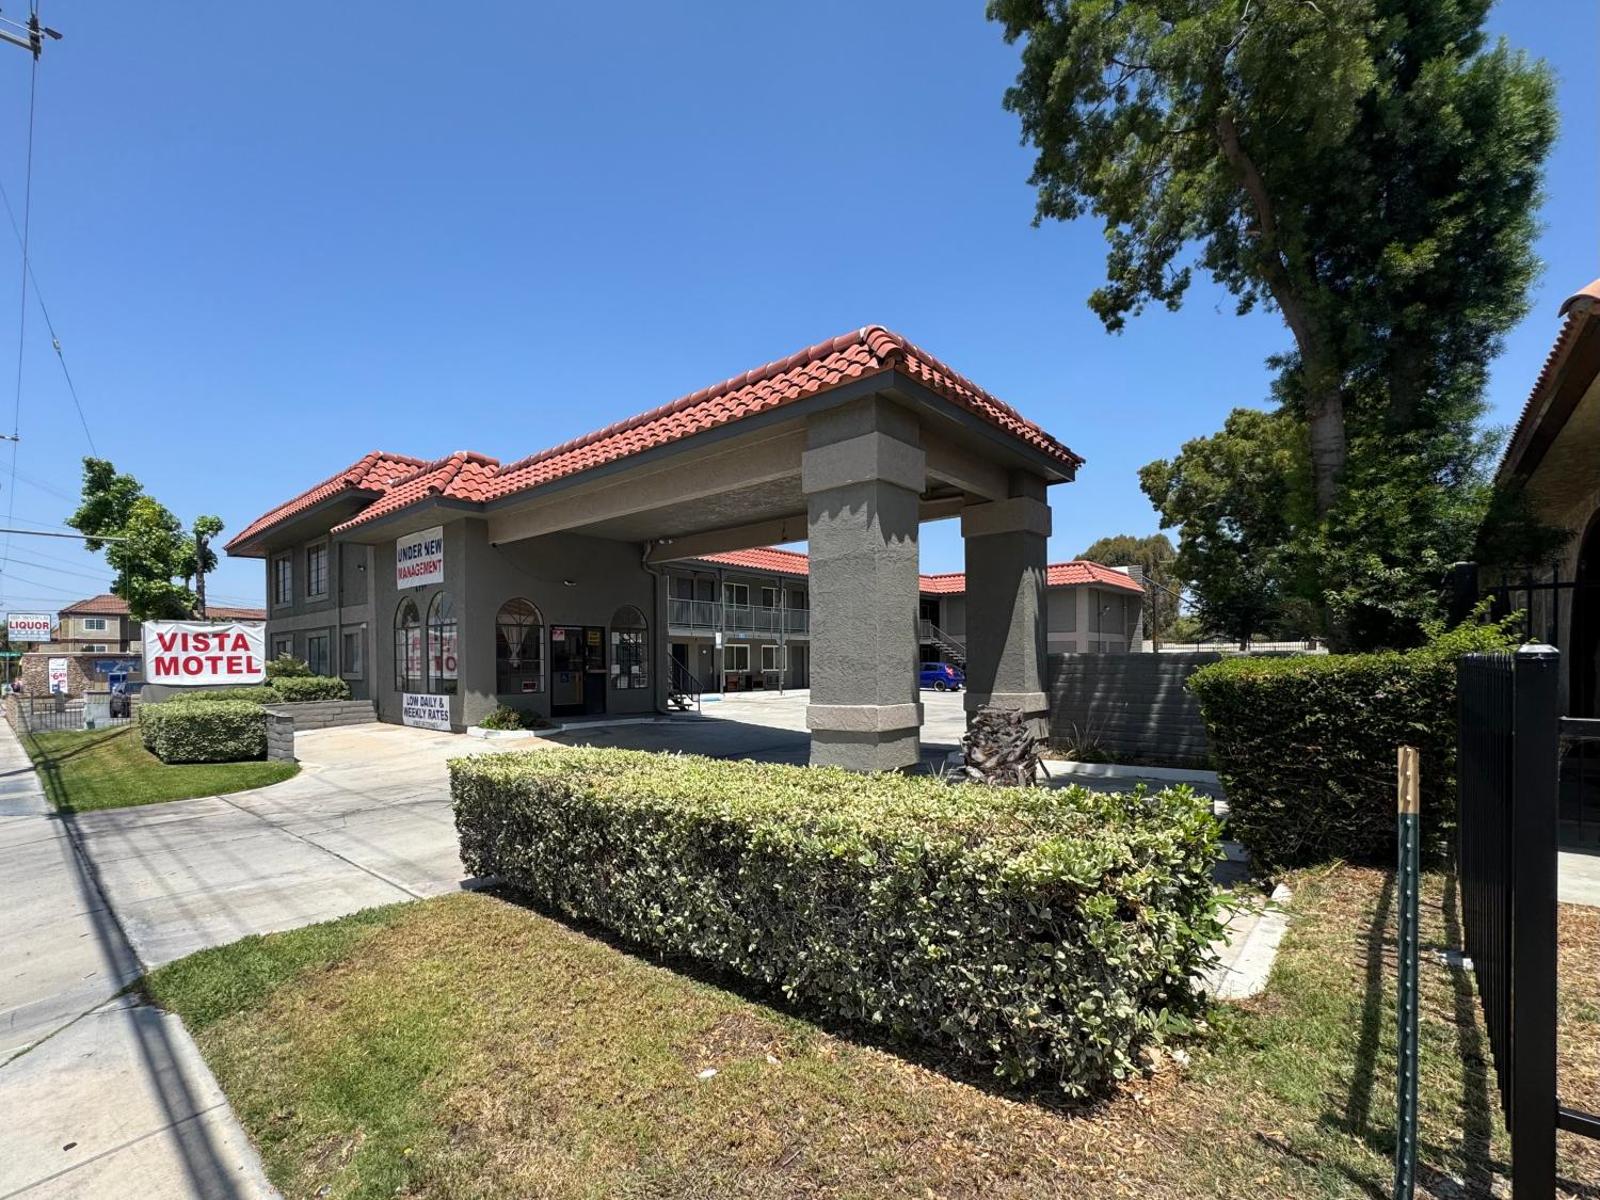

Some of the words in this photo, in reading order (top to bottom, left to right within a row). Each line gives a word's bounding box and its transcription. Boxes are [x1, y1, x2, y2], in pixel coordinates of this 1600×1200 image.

[398, 543, 422, 562] UNDER
[424, 538, 443, 556] NEW
[398, 559, 442, 580] MANAGEMENT
[9, 621, 49, 630] LIQUOR
[156, 632, 251, 652] VISTA
[154, 655, 262, 676] MOTEL
[406, 695, 419, 707] LOW
[420, 696, 437, 708] DAILY
[438, 698, 445, 708] &
[403, 706, 426, 720] WEEKLY
[427, 709, 449, 722] RATES
